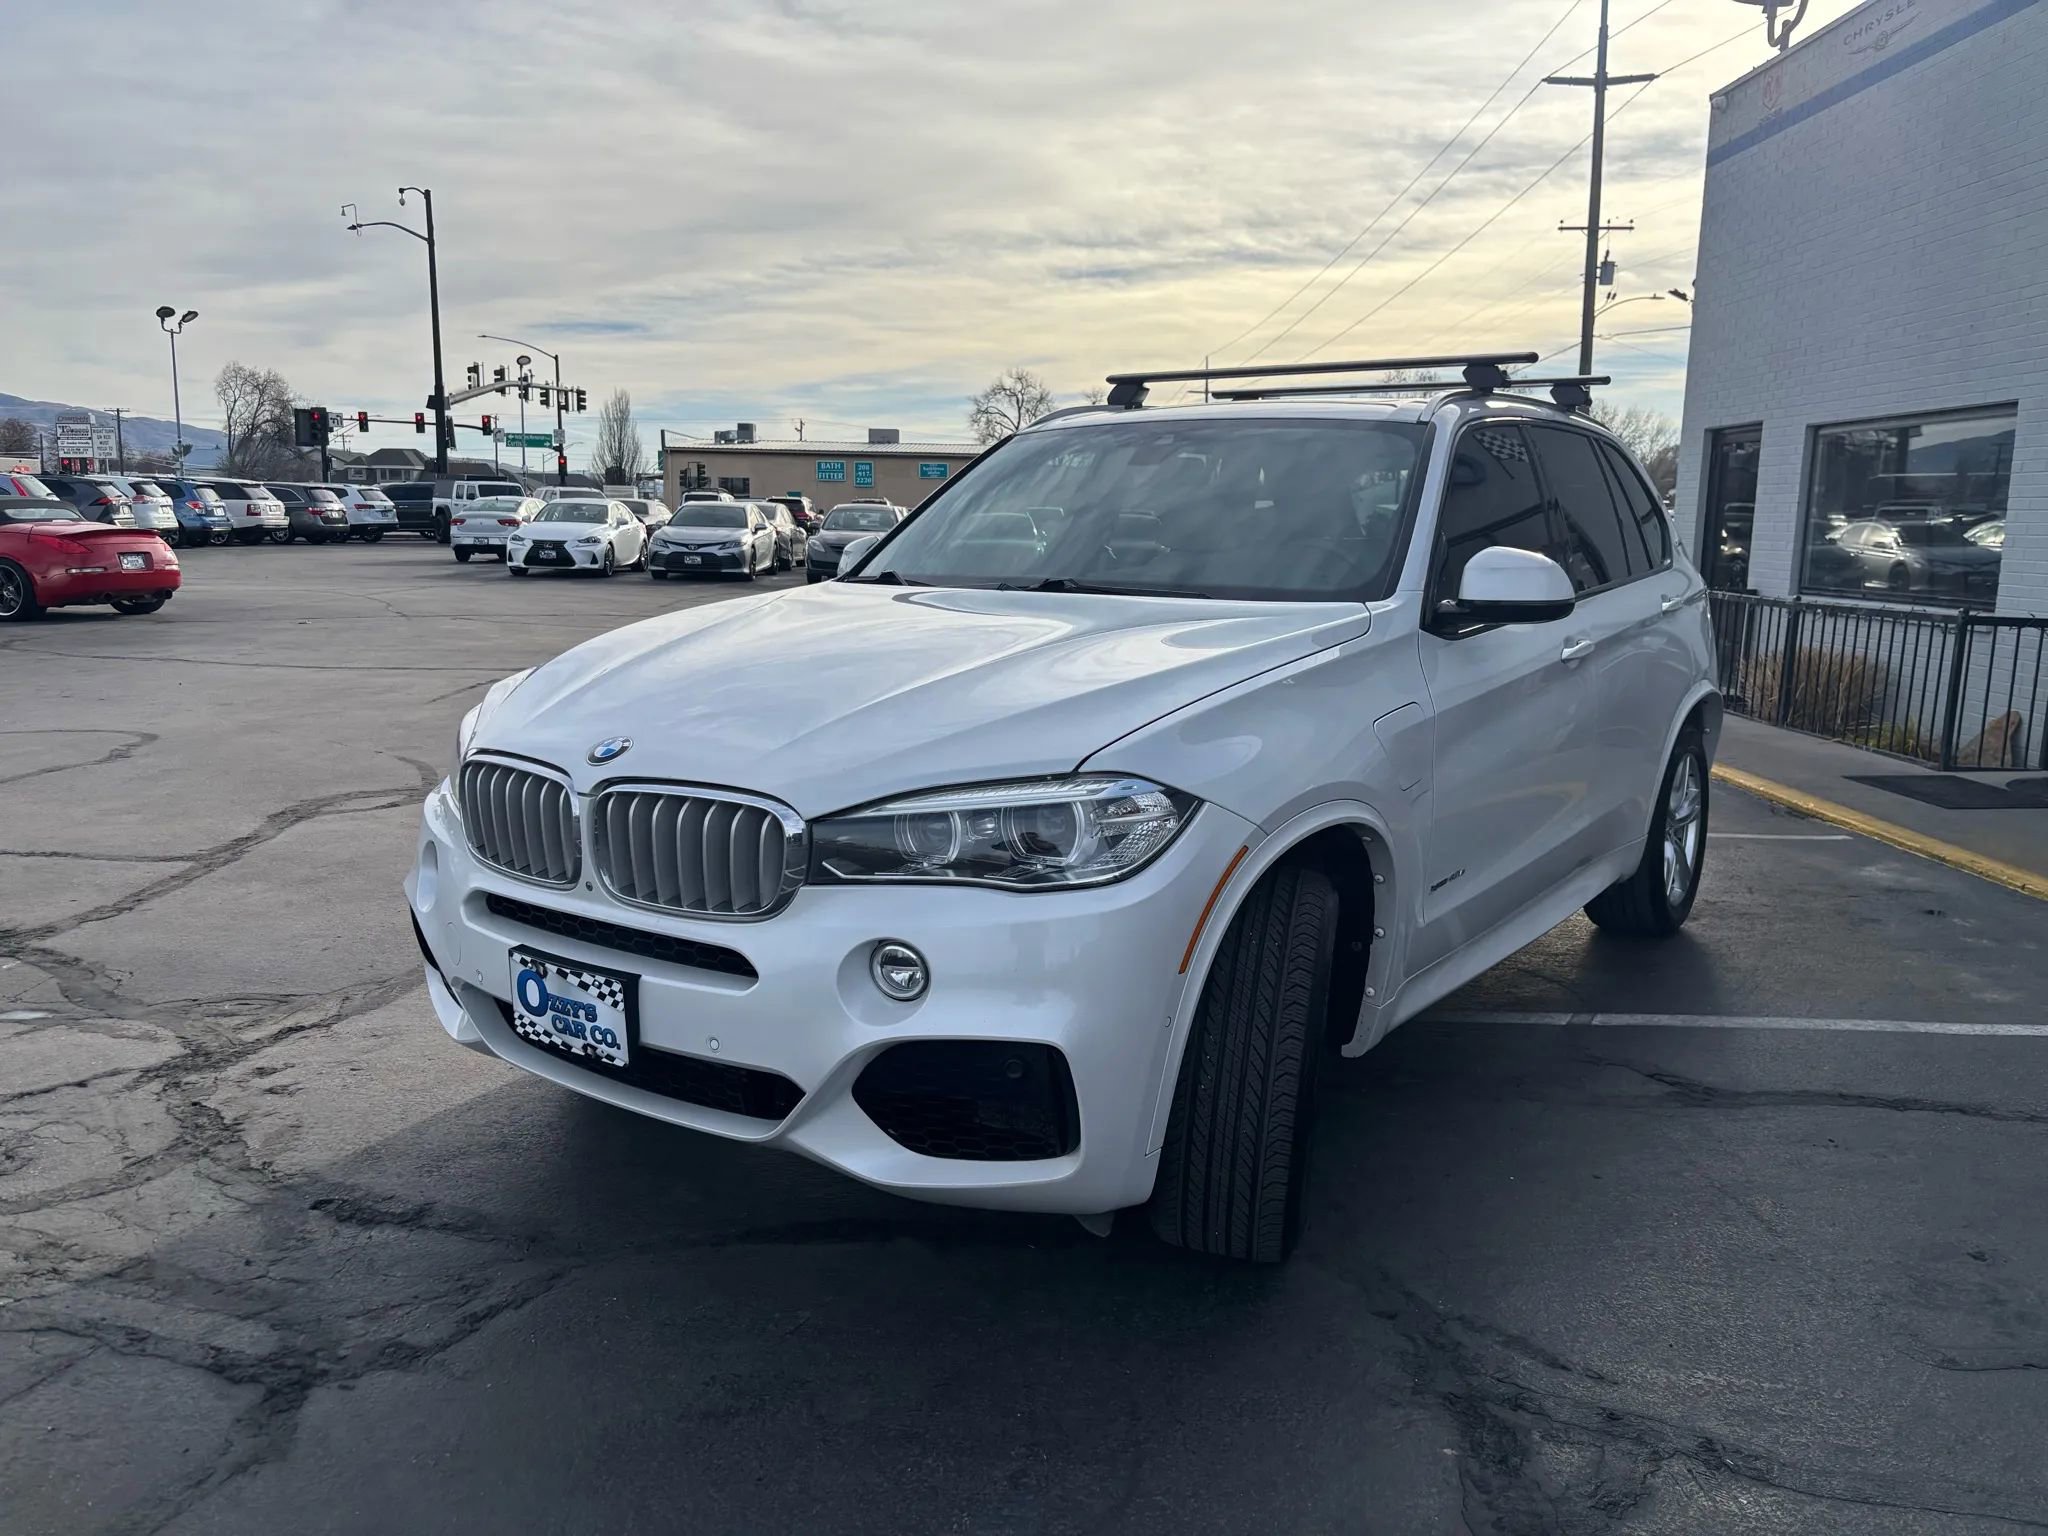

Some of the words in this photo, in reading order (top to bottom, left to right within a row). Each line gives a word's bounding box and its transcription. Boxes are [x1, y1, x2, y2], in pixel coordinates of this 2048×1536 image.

[1843, 0, 1916, 46] CHRYSLE
[818, 472, 843, 480] FITTER
[820, 462, 841, 470] BATH
[551, 1013, 588, 1042] CAR
[589, 1024, 622, 1051] CO.
